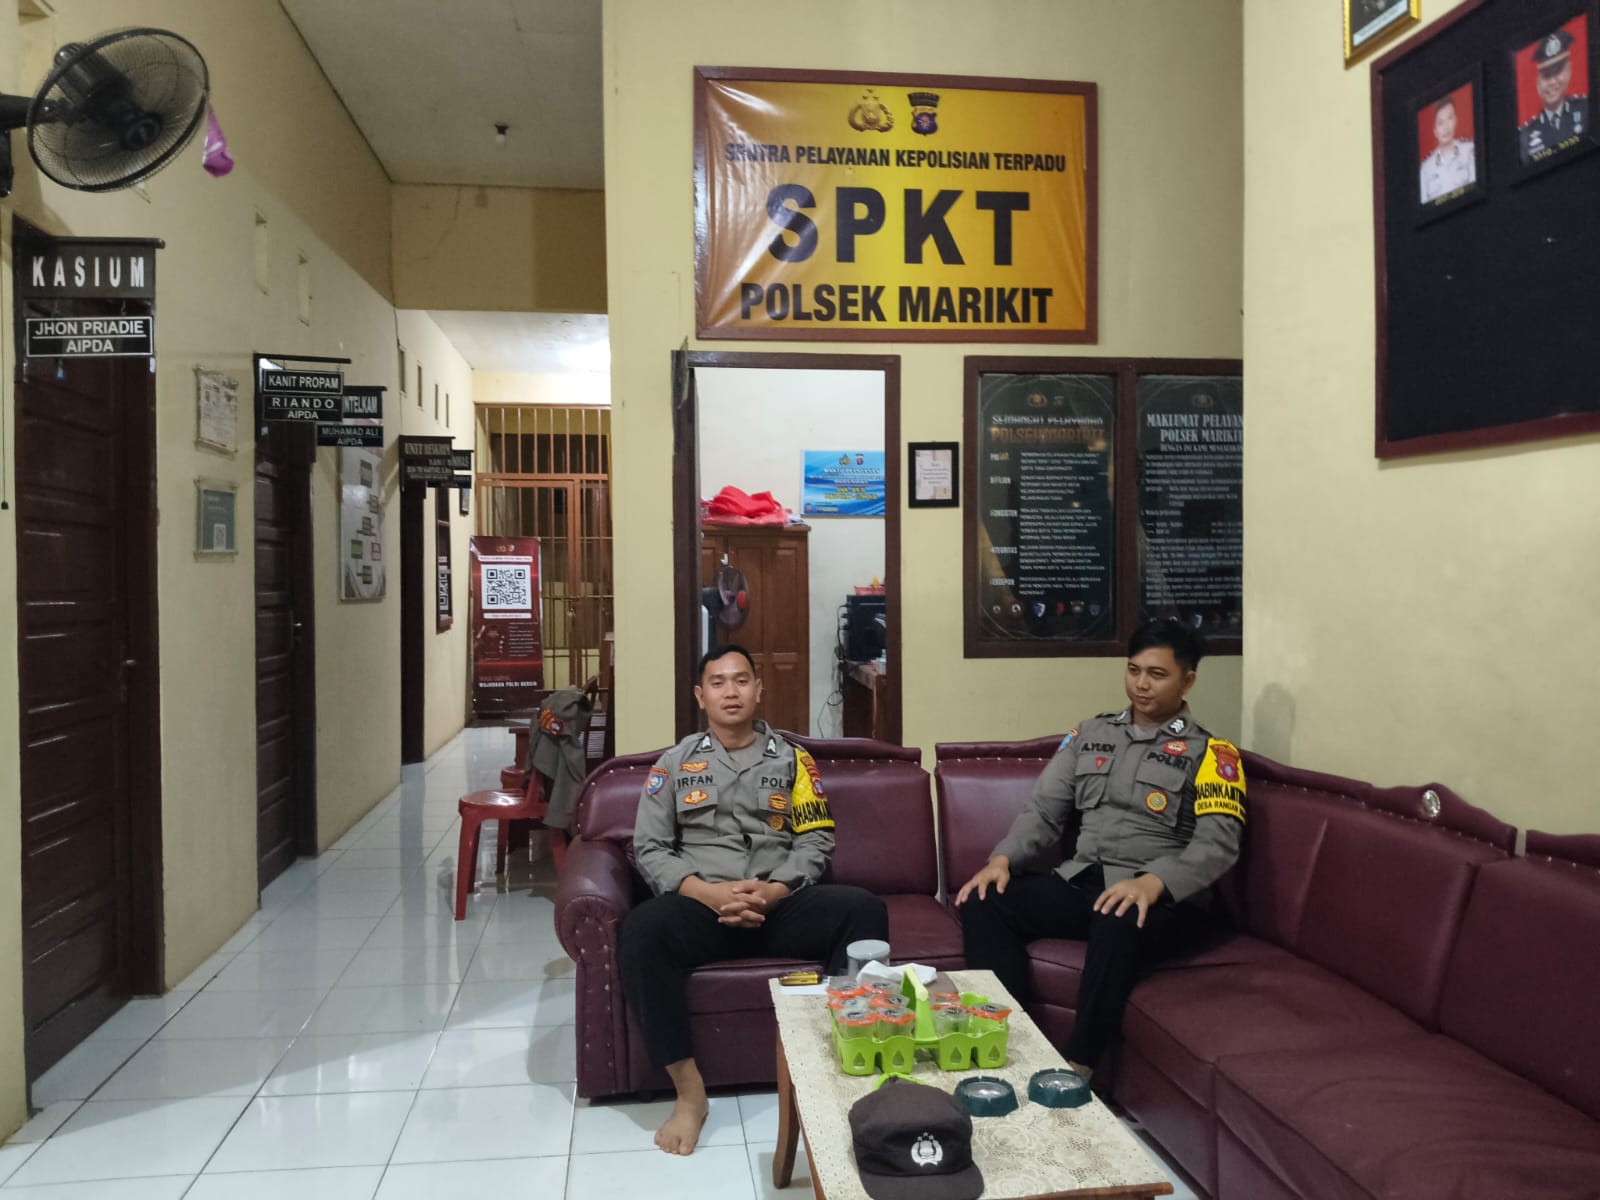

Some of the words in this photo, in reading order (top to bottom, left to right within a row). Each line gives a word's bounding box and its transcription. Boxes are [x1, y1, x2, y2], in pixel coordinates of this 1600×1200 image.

[724, 143, 791, 164] SENTRA
[795, 145, 890, 167] PELAYANAN
[895, 148, 990, 171] KEPOLISIAN
[994, 152, 1066, 173] TERPADU
[766, 183, 1031, 267] SPKT
[32, 256, 145, 287] KASIUM
[740, 282, 887, 322] POLSEK
[898, 285, 1054, 324] MARIKIT
[35, 321, 78, 336] JHON
[82, 320, 144, 335] PRIADIE
[66, 339, 115, 353] AIPDA
[268, 375, 297, 387] KANIT
[299, 376, 339, 389] PROPAM
[272, 397, 335, 409] RIANDO
[287, 410, 319, 420] AIPDA
[1146, 413, 1200, 428] MAKLUMAT
[365, 427, 378, 436] ALI
[1160, 429, 1199, 442] POLSEK
[337, 437, 363, 446] AIPDA
[1147, 752, 1187, 769] POLRI
[677, 775, 714, 789] IRFAN
